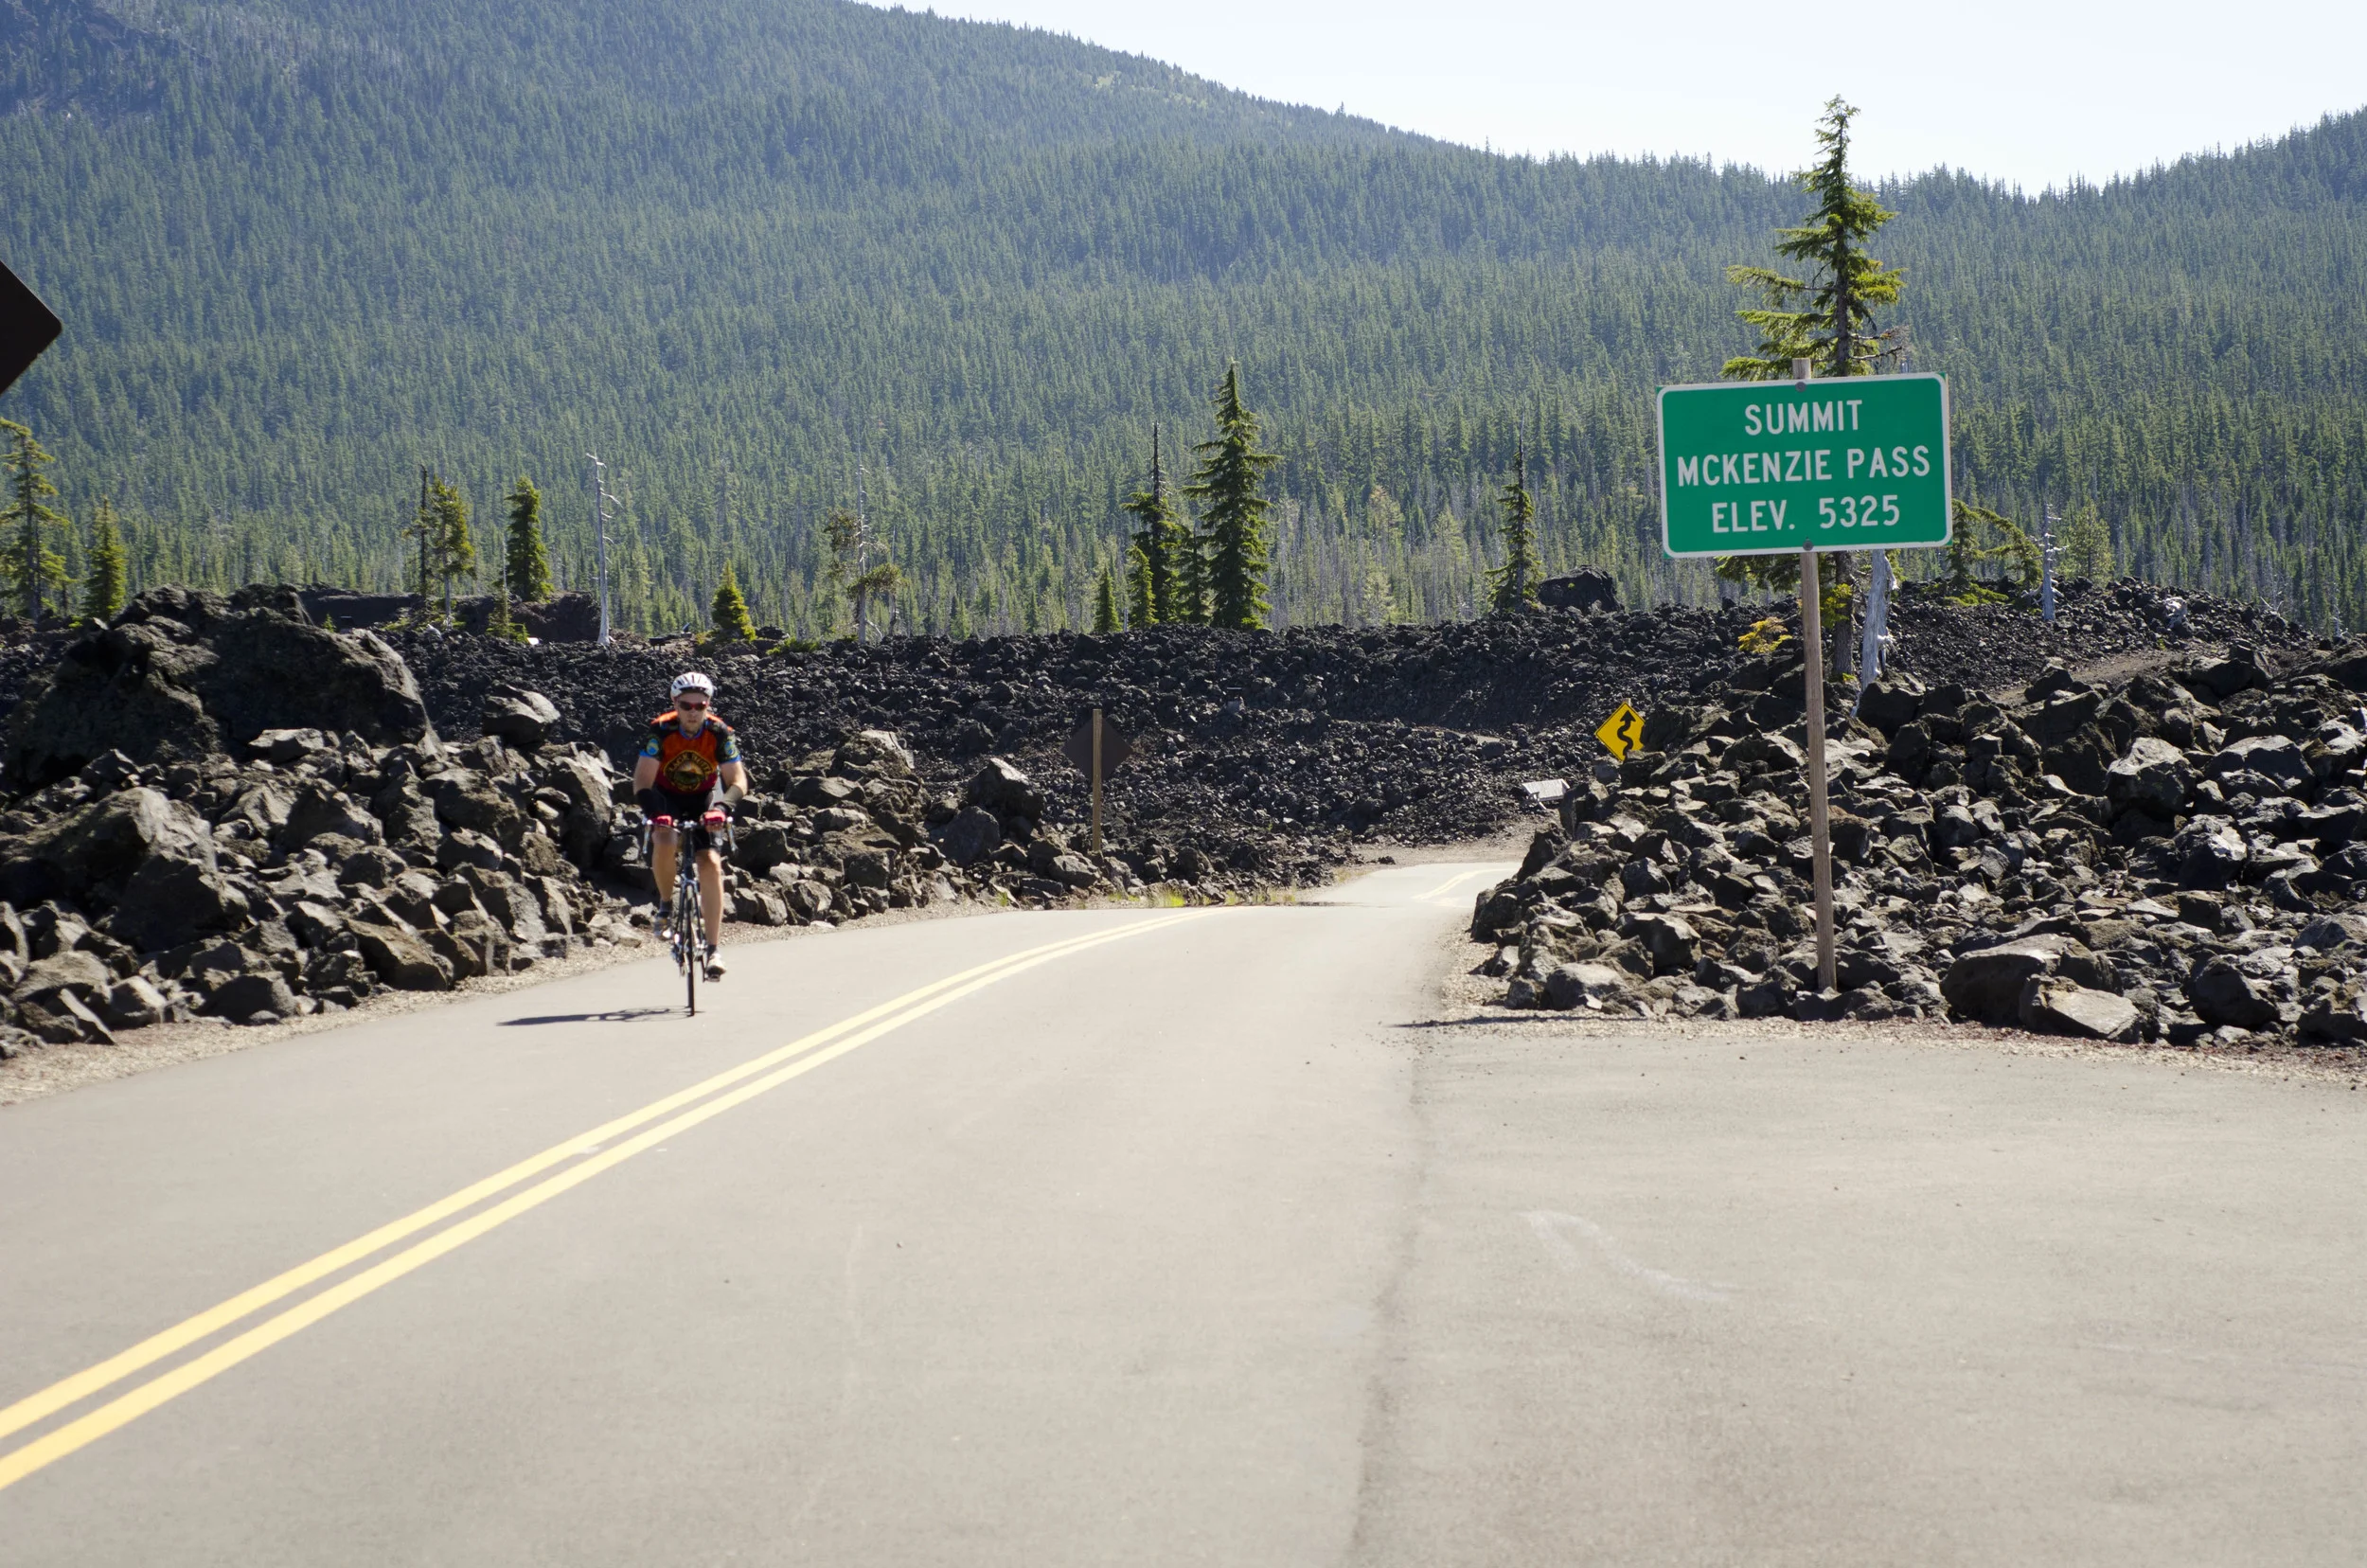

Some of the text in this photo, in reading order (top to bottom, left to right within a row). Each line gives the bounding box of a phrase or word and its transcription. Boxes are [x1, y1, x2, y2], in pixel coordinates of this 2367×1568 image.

[1745, 400, 1862, 436] SUMMIT
[1677, 445, 1931, 487] MCKENZIE PASS
[1712, 494, 1900, 533] ELEV. 5325
